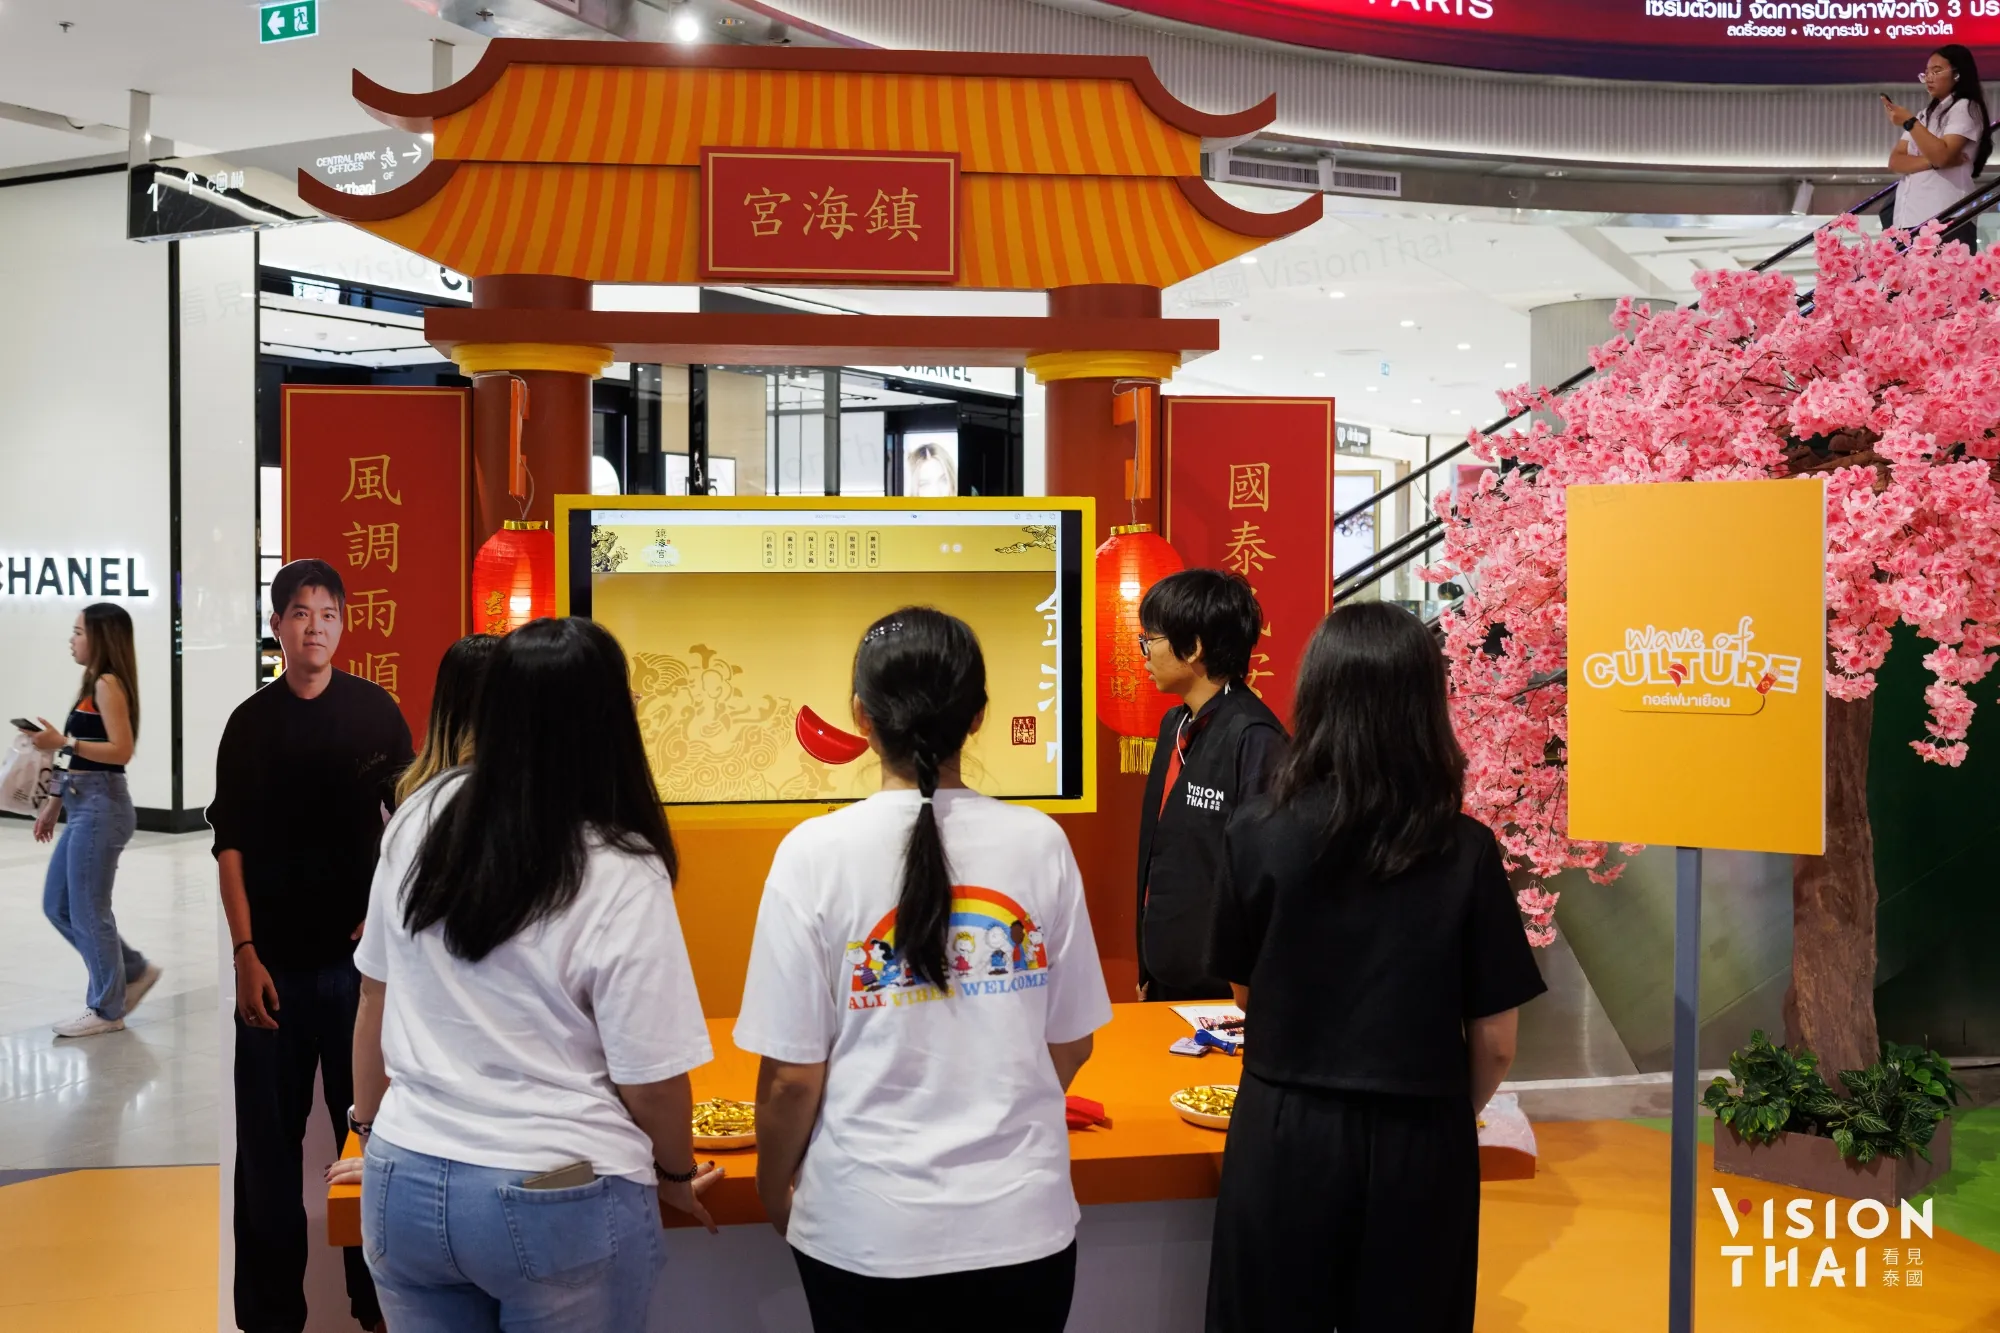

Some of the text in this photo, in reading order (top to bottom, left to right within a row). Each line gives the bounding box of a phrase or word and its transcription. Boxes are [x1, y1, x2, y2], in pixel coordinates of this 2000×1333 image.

[1948, 0, 1961, 17] 3
[316, 151, 376, 168] CENTRAL PARK
[327, 162, 364, 175] OFFICES
[0, 557, 149, 597] HANEL
[341, 454, 402, 703] 風調雨順
[1712, 615, 1755, 663] of
[1583, 649, 1802, 694] CULTURE
[1186, 794, 1209, 809] THAI
[1187, 781, 1225, 802] VISION
[848, 993, 887, 1010] ALL
[961, 972, 1048, 996] WELCOME
